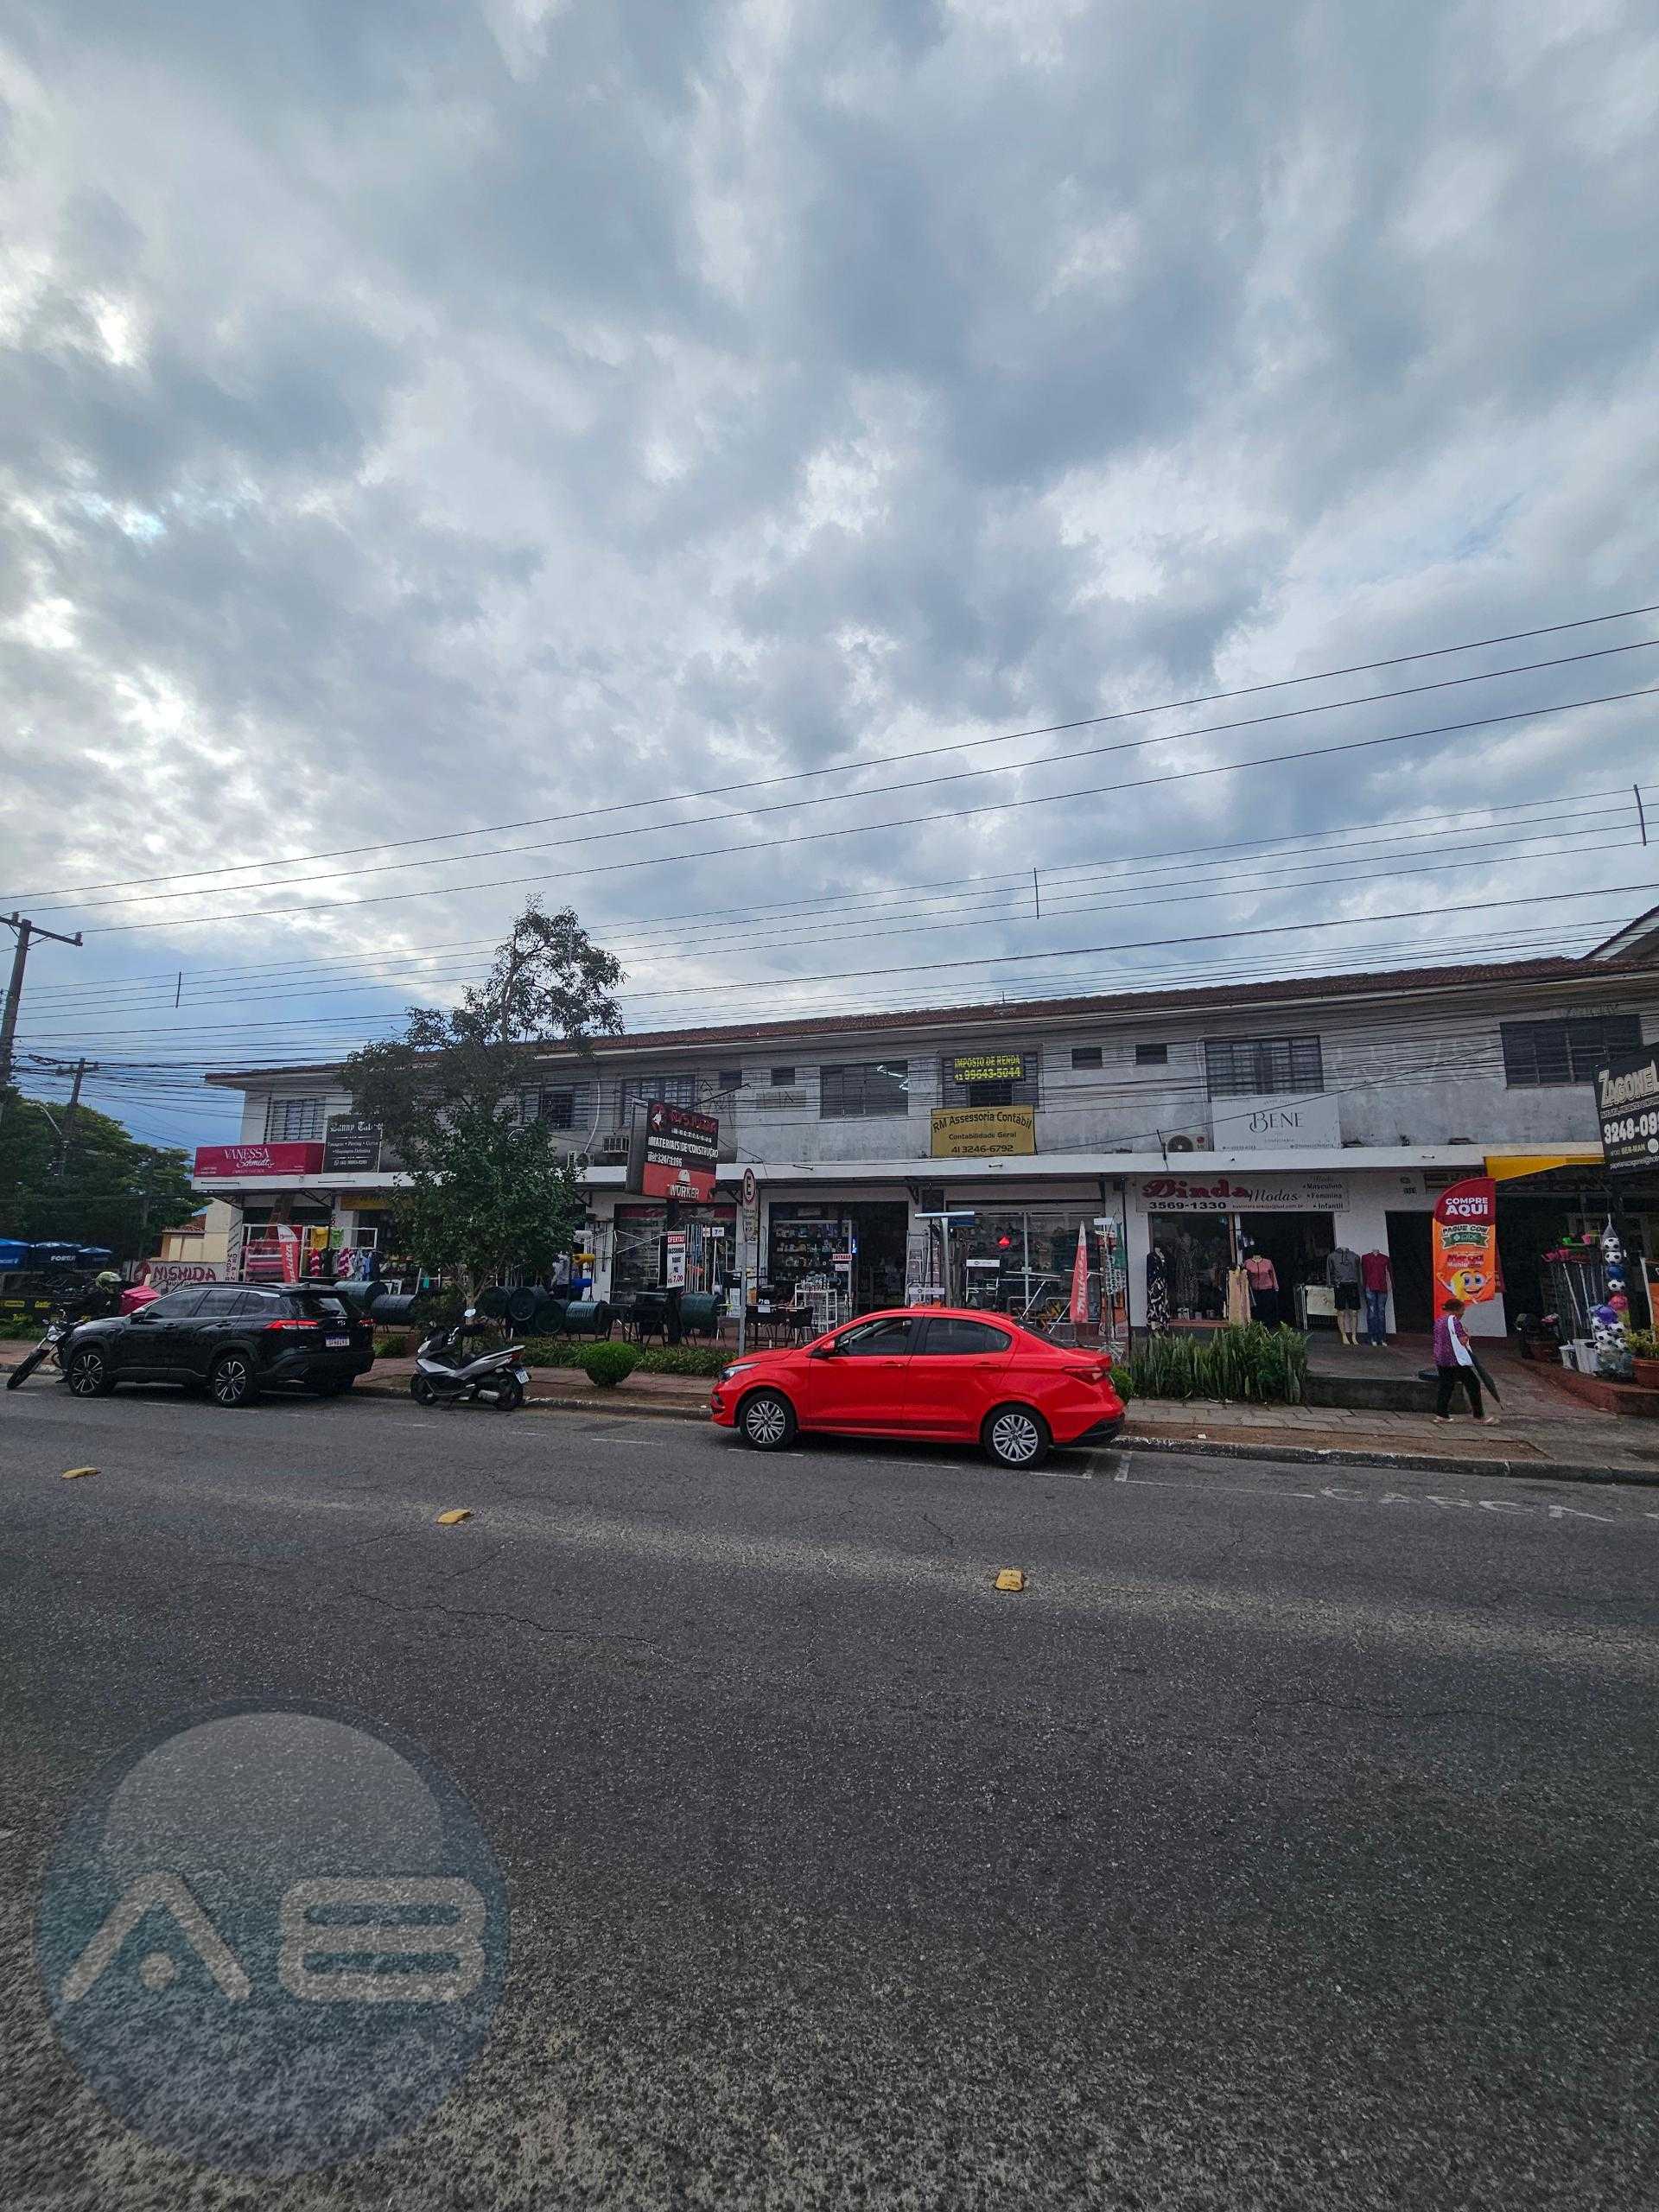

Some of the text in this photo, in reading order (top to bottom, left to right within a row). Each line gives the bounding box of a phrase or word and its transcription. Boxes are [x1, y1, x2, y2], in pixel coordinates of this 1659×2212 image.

[986, 1056, 995, 1065] DE
[997, 1055, 1020, 1065] RENDA
[933, 1117, 948, 1132] RM
[950, 1112, 995, 1125] Assessoria
[1249, 1112, 1306, 1133] BENE
[225, 1148, 270, 1159] VANESSA
[963, 1144, 1014, 1153] 3246-6792
[670, 1185, 700, 1198] WORKER
[1141, 1179, 1247, 1198] Dinda
[1244, 1189, 1299, 1202] Modas
[1148, 1201, 1227, 1210] 3569-1330
[1446, 1205, 1488, 1217] AQUI
